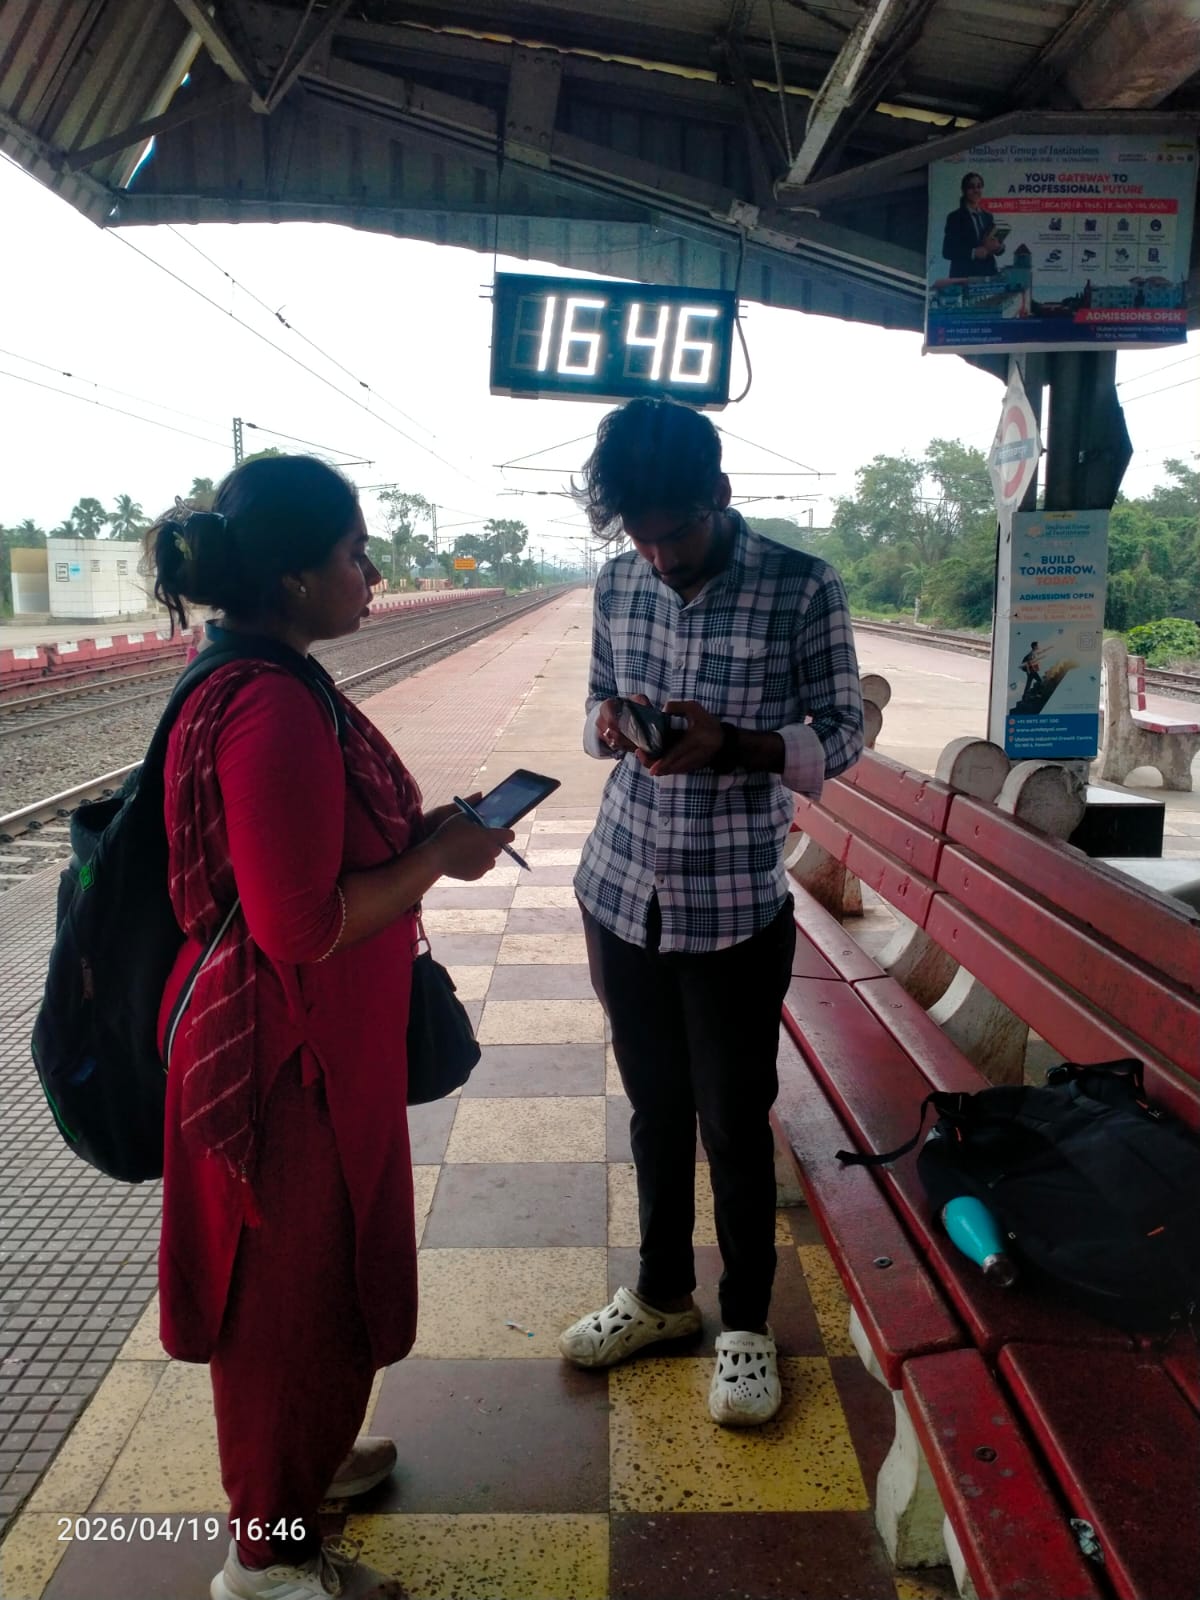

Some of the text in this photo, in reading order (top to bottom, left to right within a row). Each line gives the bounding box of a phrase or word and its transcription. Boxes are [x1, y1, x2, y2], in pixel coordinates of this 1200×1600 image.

[1025, 173, 1128, 183] YOUR GATEWAY TO
[1008, 184, 1144, 194] A PROFESSIONAL FUTURE
[1086, 312, 1182, 321] ADMISSIONS OPEN
[1041, 555, 1076, 565] BUILD
[1019, 592, 1095, 601] ADMISSIONS OPEN
